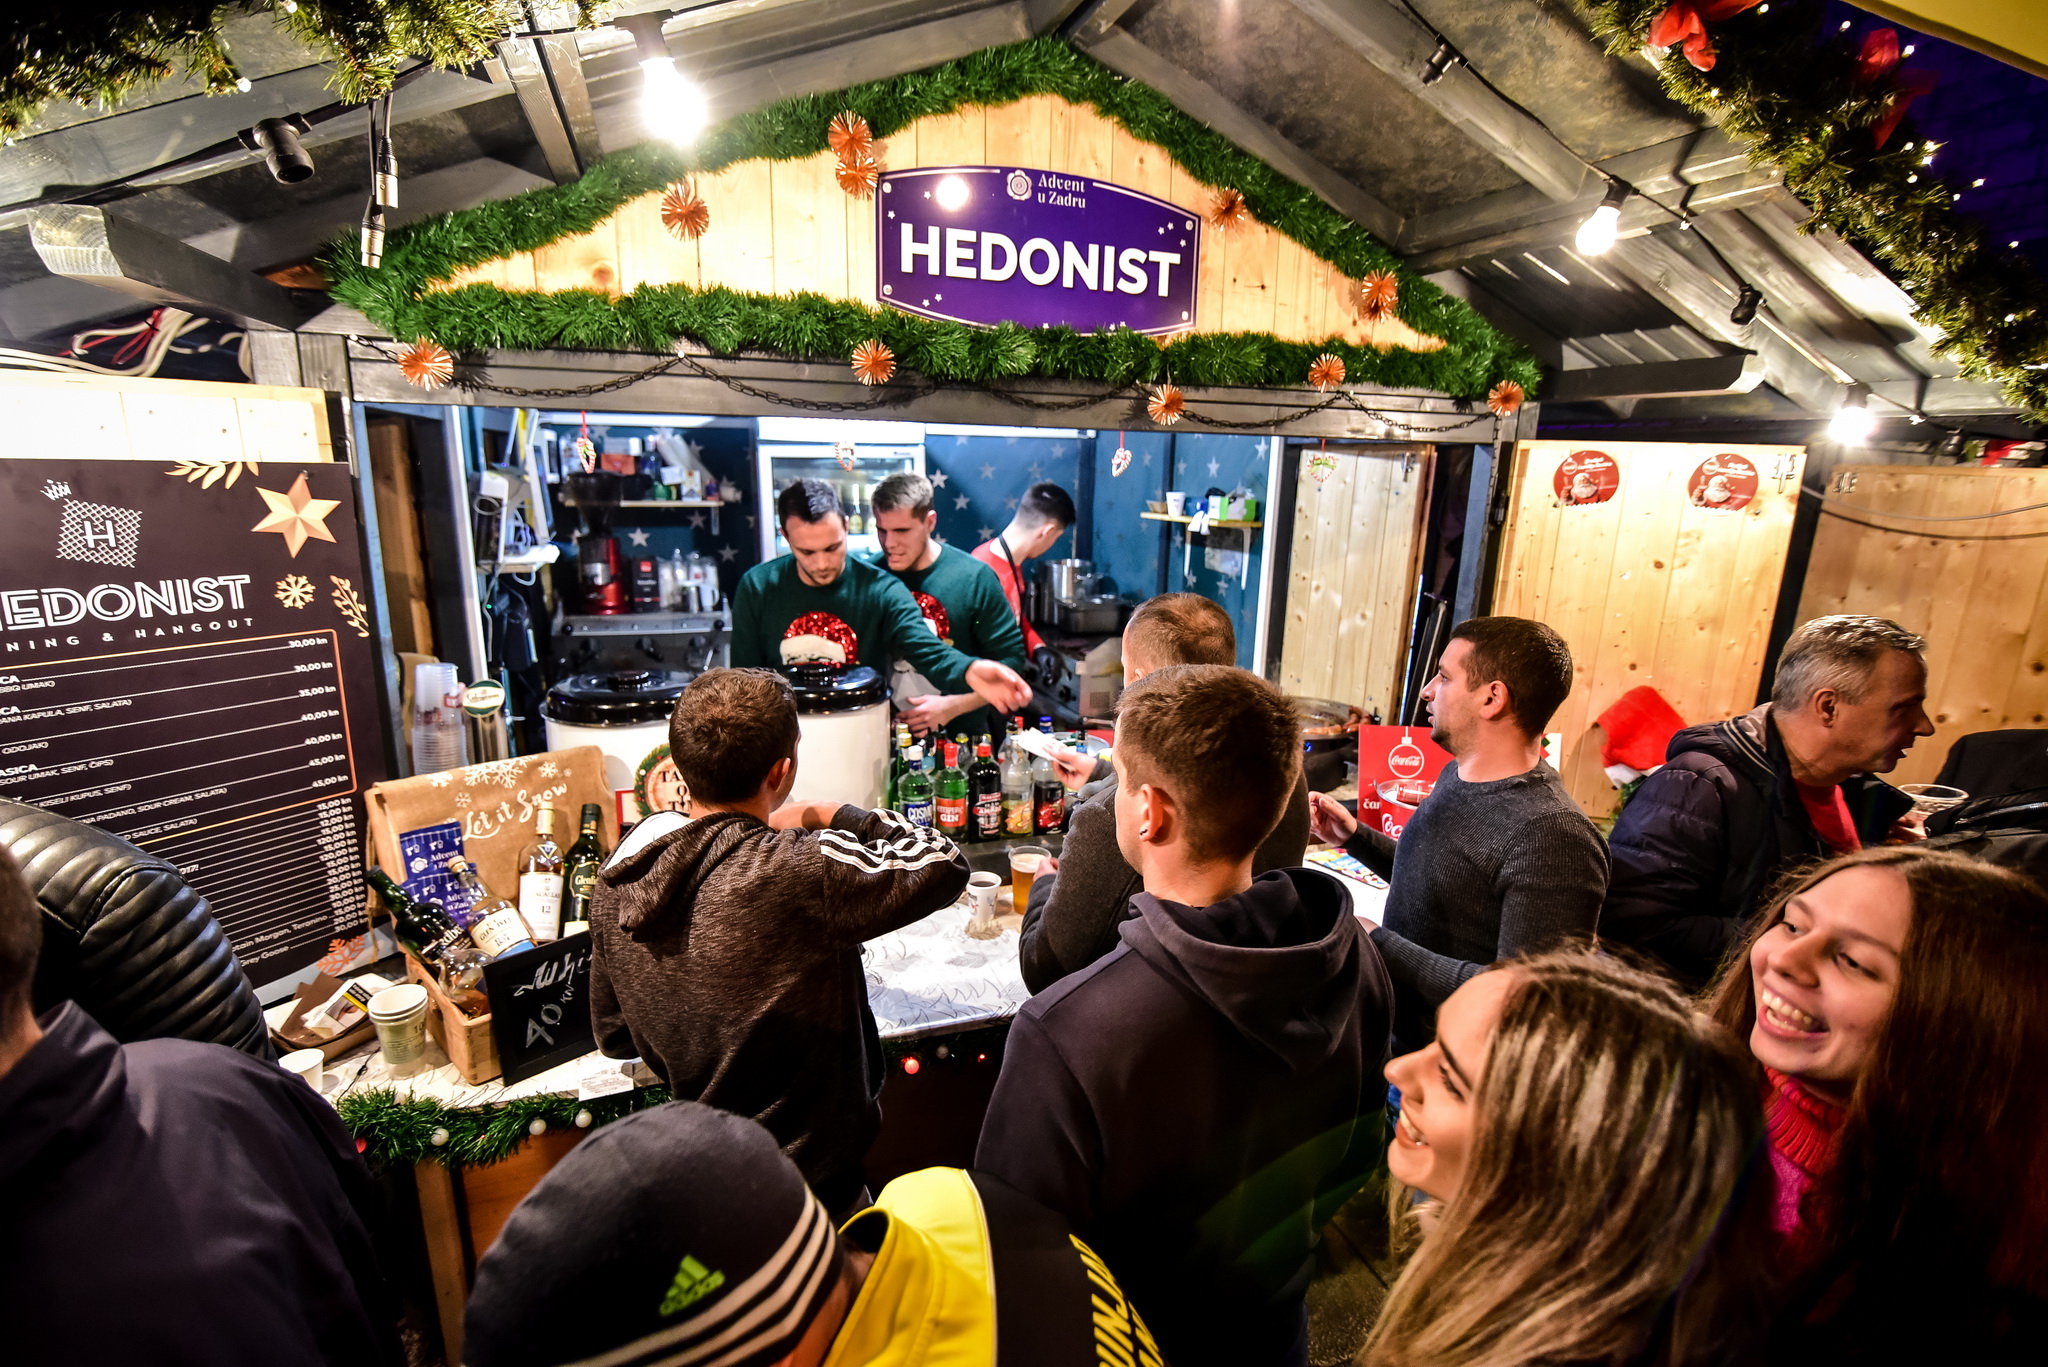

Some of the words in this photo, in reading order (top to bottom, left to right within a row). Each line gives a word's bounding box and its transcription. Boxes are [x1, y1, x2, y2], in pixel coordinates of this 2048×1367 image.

[1038, 173, 1086, 193] Advent
[1037, 192, 1046, 204] u
[1048, 190, 1086, 209] Zadru
[900, 222, 1181, 298] HEDONIST
[0, 574, 251, 632] EDONIST
[102, 632, 114, 641] &
[134, 617, 253, 638] HANGOUT
[288, 638, 316, 648] 30,00
[316, 637, 328, 645] kn
[294, 662, 321, 673] 30,00
[321, 661, 333, 669] kn
[298, 686, 325, 697] 35,00
[325, 685, 336, 693] kn
[94, 699, 132, 710] SALATA)
[301, 710, 328, 722] 40,00
[304, 734, 330, 745] 40,00
[331, 732, 343, 740] kn
[308, 755, 334, 766] 45,00
[312, 776, 337, 788] 45,00
[337, 774, 348, 782] kn
[104, 783, 132, 794] SENF)
[97, 807, 137, 822] PADANO,
[137, 802, 163, 813] SOUR
[162, 795, 194, 807] CREAM,
[194, 788, 228, 800] SALATA)
[462, 811, 501, 842] Let
[496, 801, 515, 823] it
[516, 783, 568, 824] Snow
[940, 813, 959, 822] GIN
[131, 827, 163, 840] SAUCE,
[163, 818, 198, 832] SALATA)
[344, 822, 355, 830] kn
[346, 830, 356, 838] kn
[346, 838, 358, 846] kn
[348, 846, 358, 854] kn
[541, 905, 551, 914] 12
[255, 928, 291, 944] Morgan,
[260, 945, 289, 959] Goose
[525, 1003, 563, 1049] 40
[659, 1269, 725, 1317] adidas
